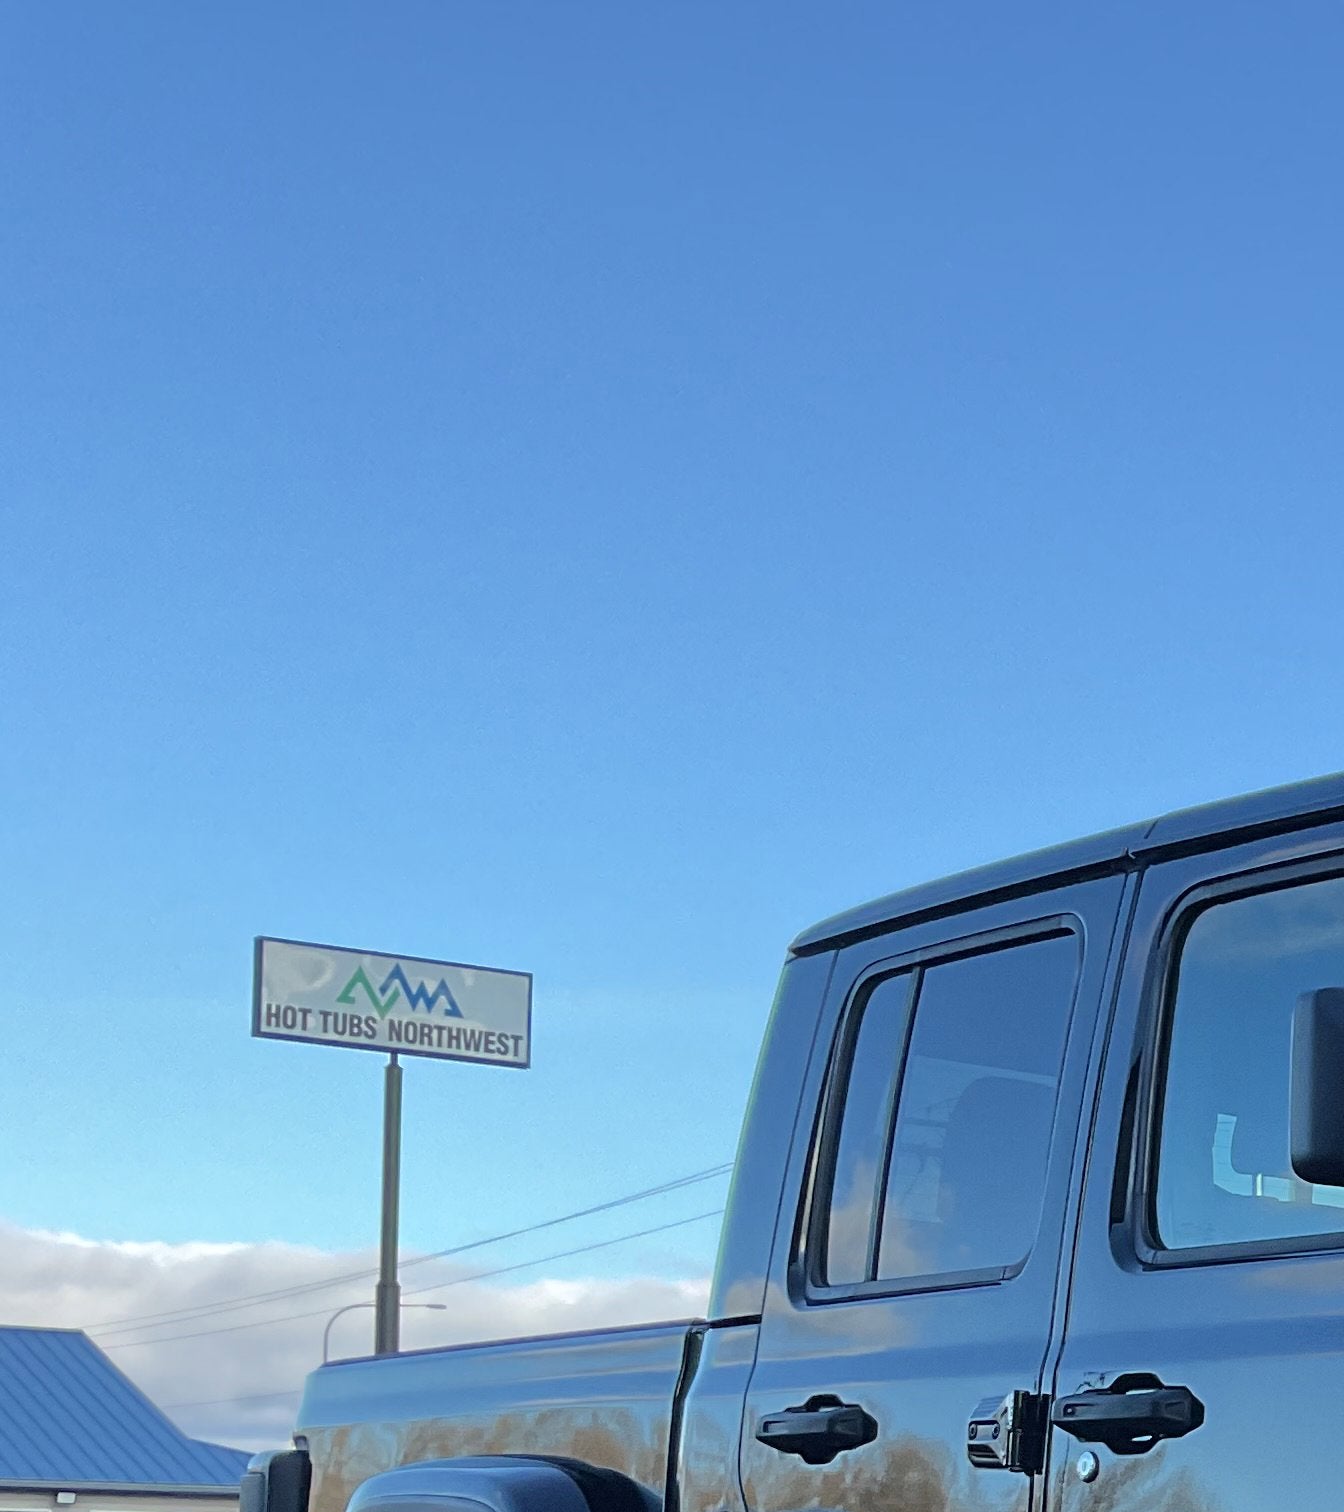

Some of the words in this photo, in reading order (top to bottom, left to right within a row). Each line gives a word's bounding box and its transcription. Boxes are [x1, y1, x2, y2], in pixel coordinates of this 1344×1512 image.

[265, 1003, 312, 1031] HOT
[319, 1009, 377, 1040] TUBS
[387, 1018, 524, 1057] NORTHWEST
